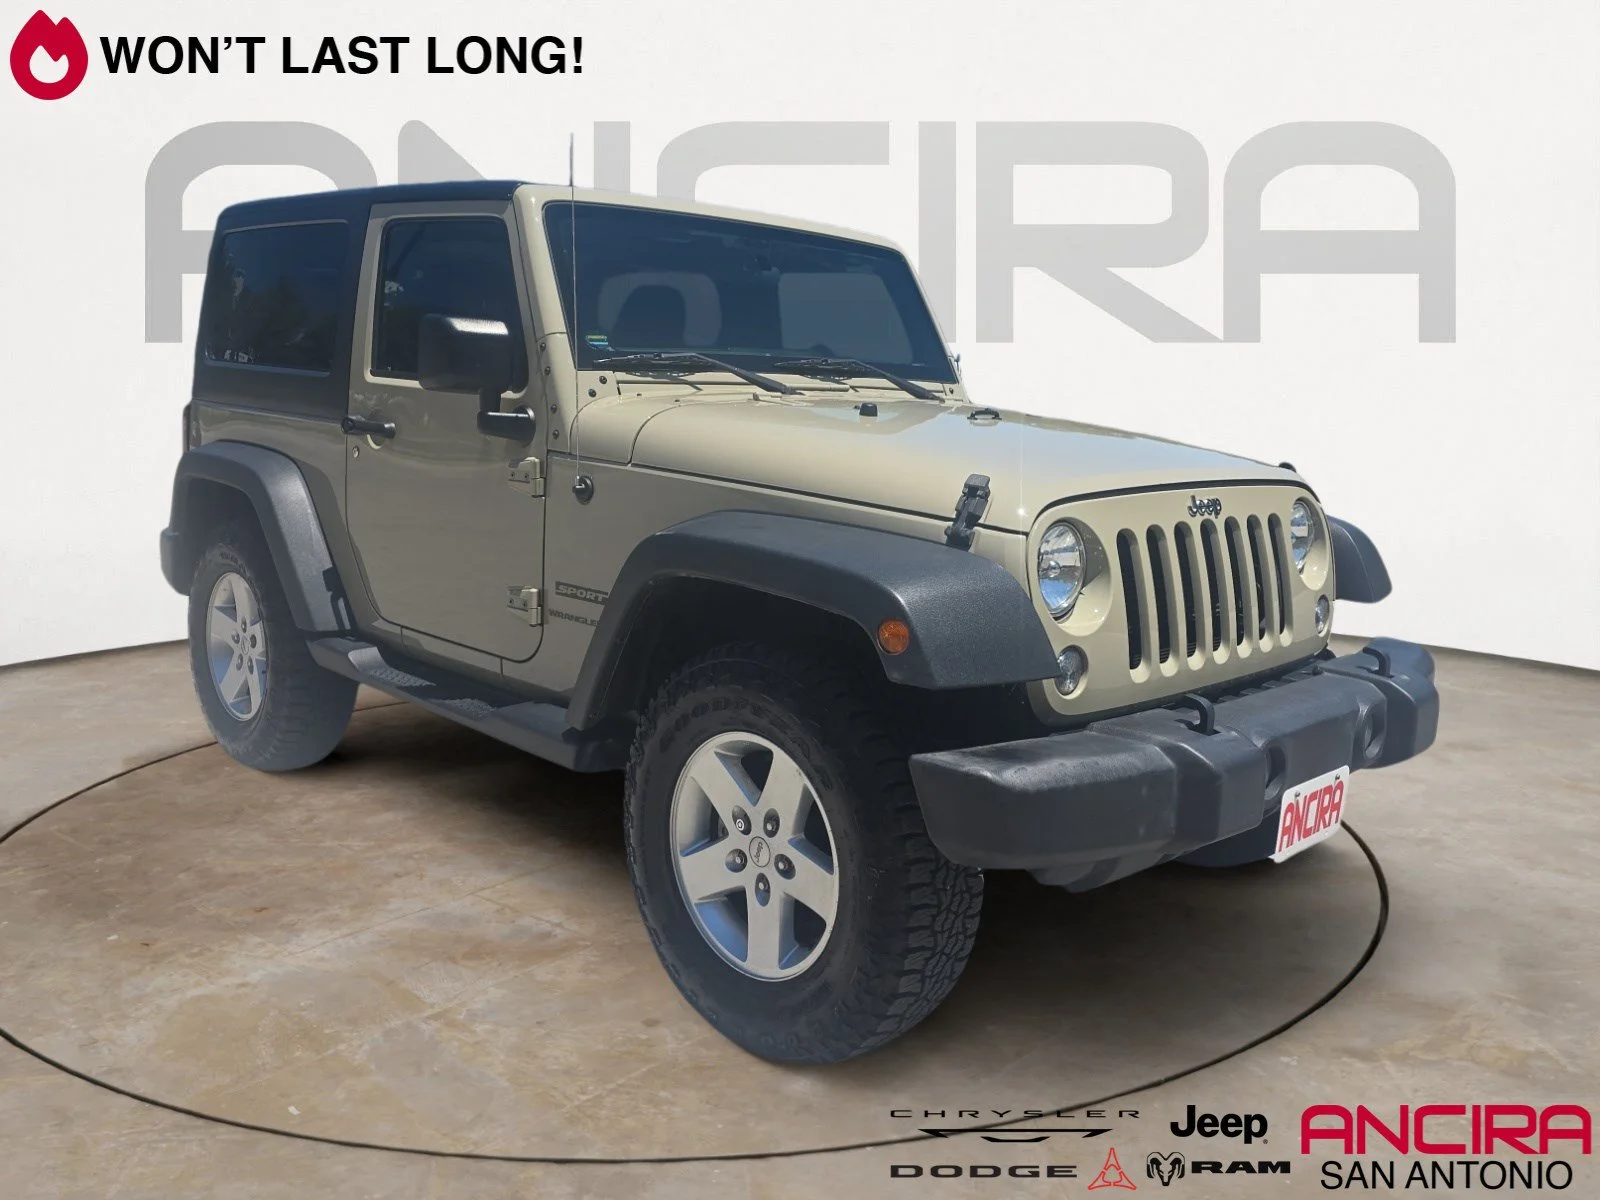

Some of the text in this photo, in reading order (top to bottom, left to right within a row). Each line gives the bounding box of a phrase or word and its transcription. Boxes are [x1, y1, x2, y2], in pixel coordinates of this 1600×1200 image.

[1187, 495, 1221, 519] Jeep
[555, 583, 609, 603] SPORT
[547, 607, 600, 627] WRANGLE
[1279, 780, 1344, 852] ANCIRA
